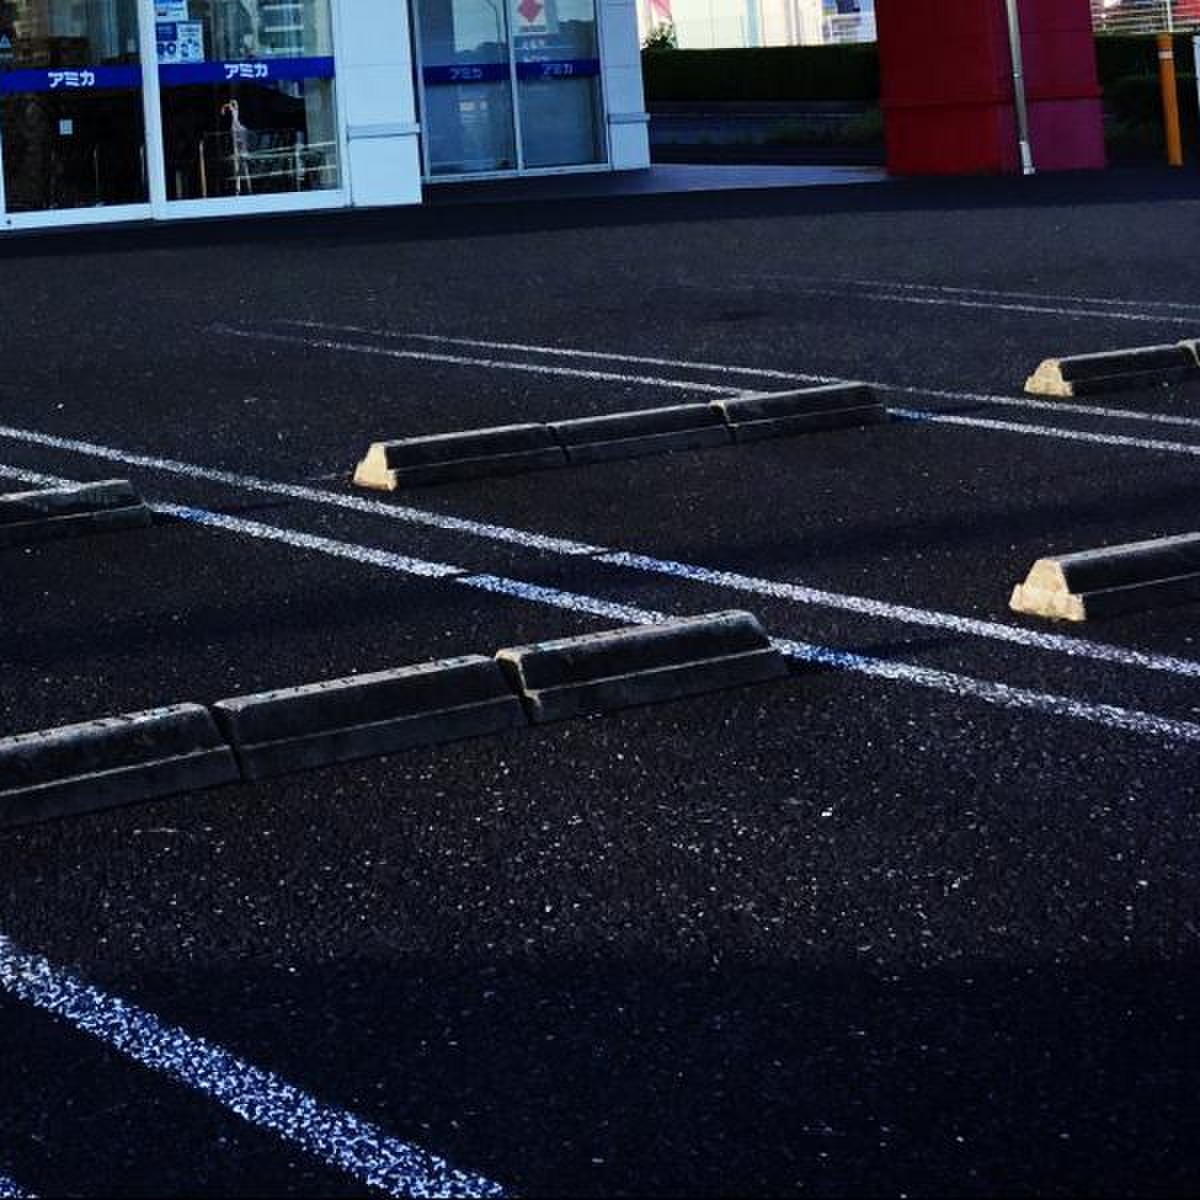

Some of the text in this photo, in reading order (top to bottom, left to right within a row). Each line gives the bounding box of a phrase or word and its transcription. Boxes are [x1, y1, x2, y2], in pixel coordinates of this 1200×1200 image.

[47, 70, 96, 88] アミカ
[224, 62, 269, 79] アミカ
